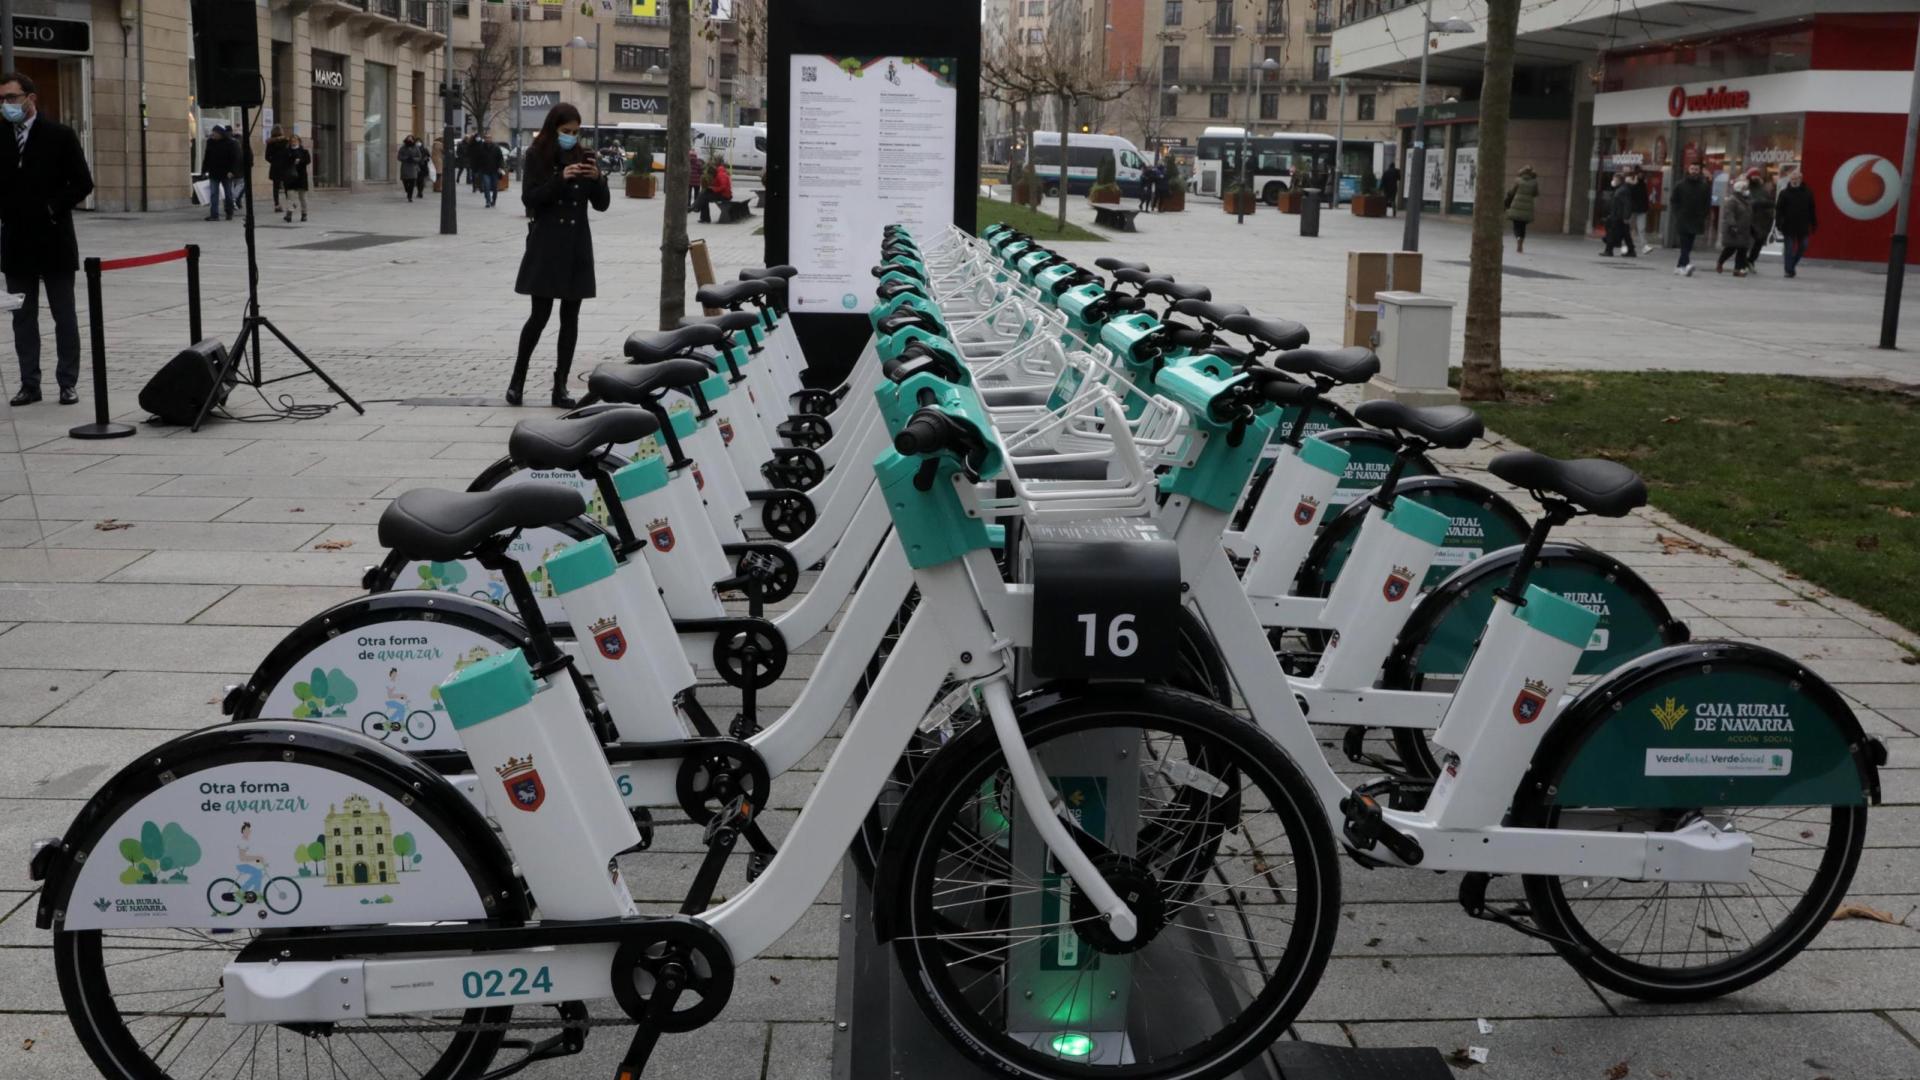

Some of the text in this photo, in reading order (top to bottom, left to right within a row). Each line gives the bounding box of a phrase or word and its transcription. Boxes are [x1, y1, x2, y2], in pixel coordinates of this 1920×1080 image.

[315, 69, 343, 87] MANGO
[521, 95, 551, 107] BBVA
[621, 98, 659, 110] BBVA
[1686, 86, 1750, 113] vodafone
[1612, 150, 1644, 165] vodafone
[1750, 147, 1795, 162] vodafone
[1345, 462, 1391, 472] AJA RURA
[551, 471, 577, 479] forma
[1446, 527, 1485, 537] VARRA
[1563, 592, 1606, 604] RURAL
[357, 635, 428, 647] Otra forma
[1077, 613, 1139, 657] 16
[358, 647, 443, 662] de avanzar
[1695, 703, 1790, 718] CAJA RURAL
[1694, 718, 1795, 732] DE NAVARRA
[199, 780, 290, 795] Otra forma
[201, 795, 310, 815] de avanzar
[462, 966, 553, 999] 0224
